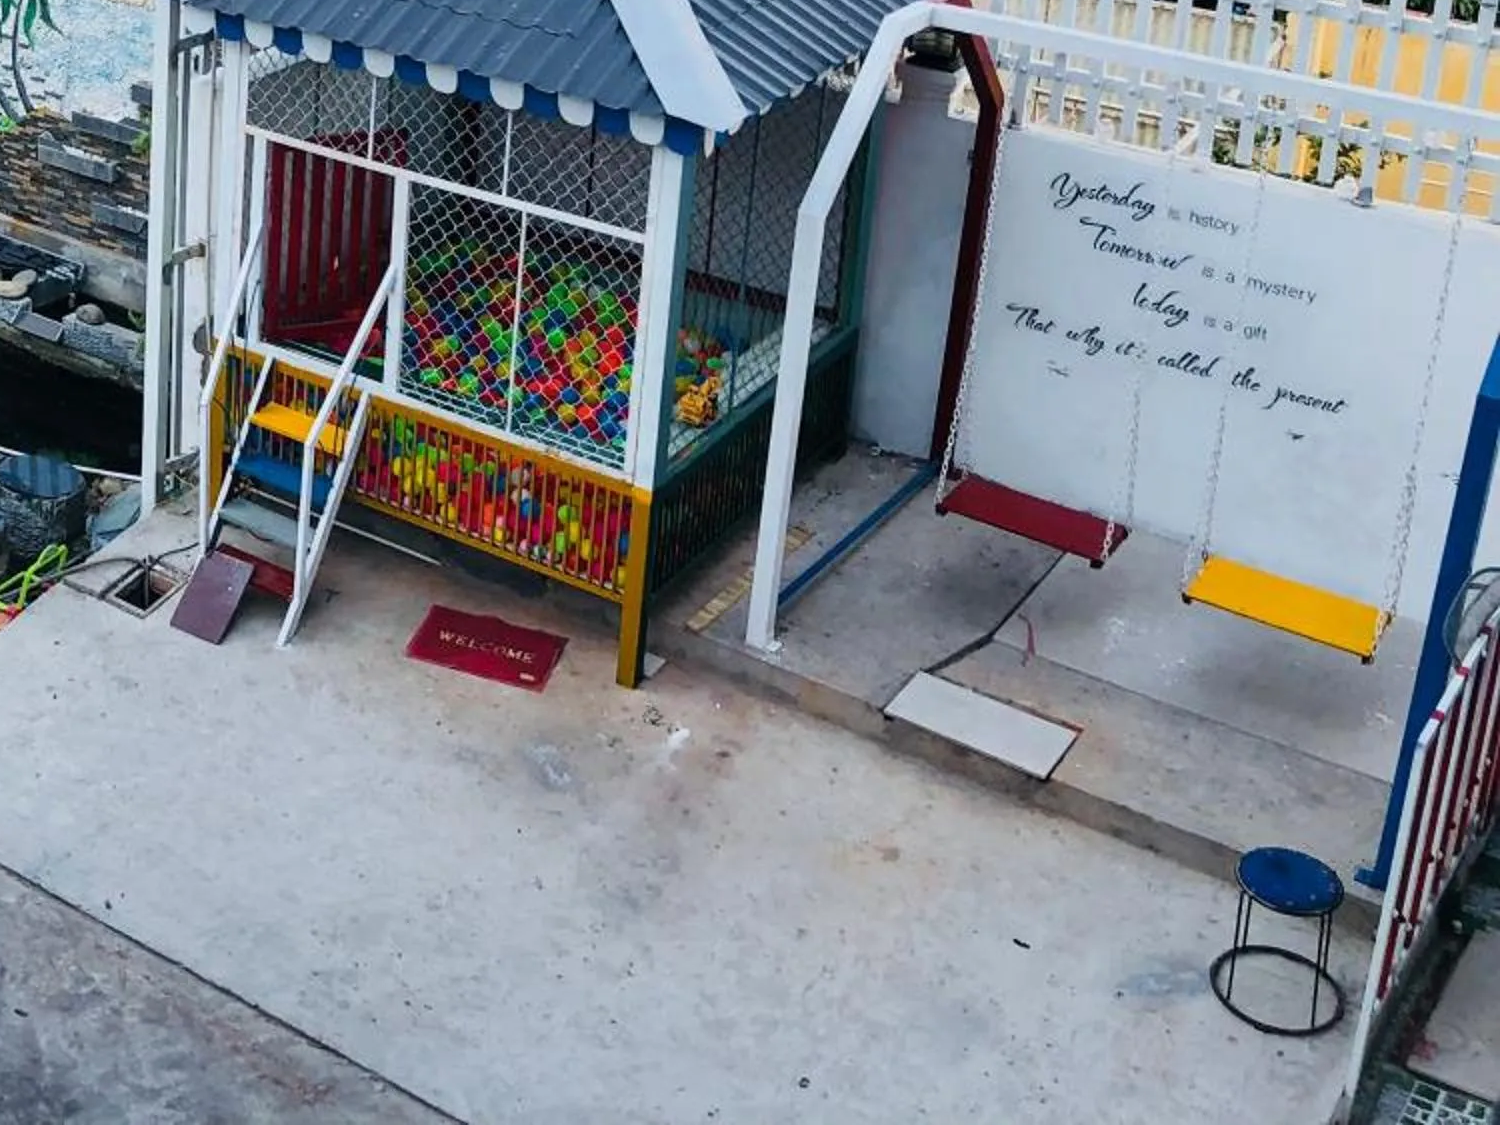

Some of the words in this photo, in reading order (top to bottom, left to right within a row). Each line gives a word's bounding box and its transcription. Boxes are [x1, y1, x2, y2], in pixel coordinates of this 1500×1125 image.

[1050, 173, 1156, 221] Yesterday
[1189, 210, 1241, 235] history
[1079, 216, 1195, 270] Tomorrw
[1202, 265, 1215, 279] is
[1225, 272, 1236, 284] a
[1247, 275, 1318, 304] mystery
[1006, 303, 1056, 334] That
[1066, 326, 1105, 356] why
[1157, 351, 1224, 378] called
[1231, 367, 1261, 392] the
[1261, 386, 1348, 414] present
[1203, 315, 1217, 328] is
[1223, 320, 1234, 332] a
[1243, 323, 1268, 341] gift
[439, 630, 534, 664] WELCOME
